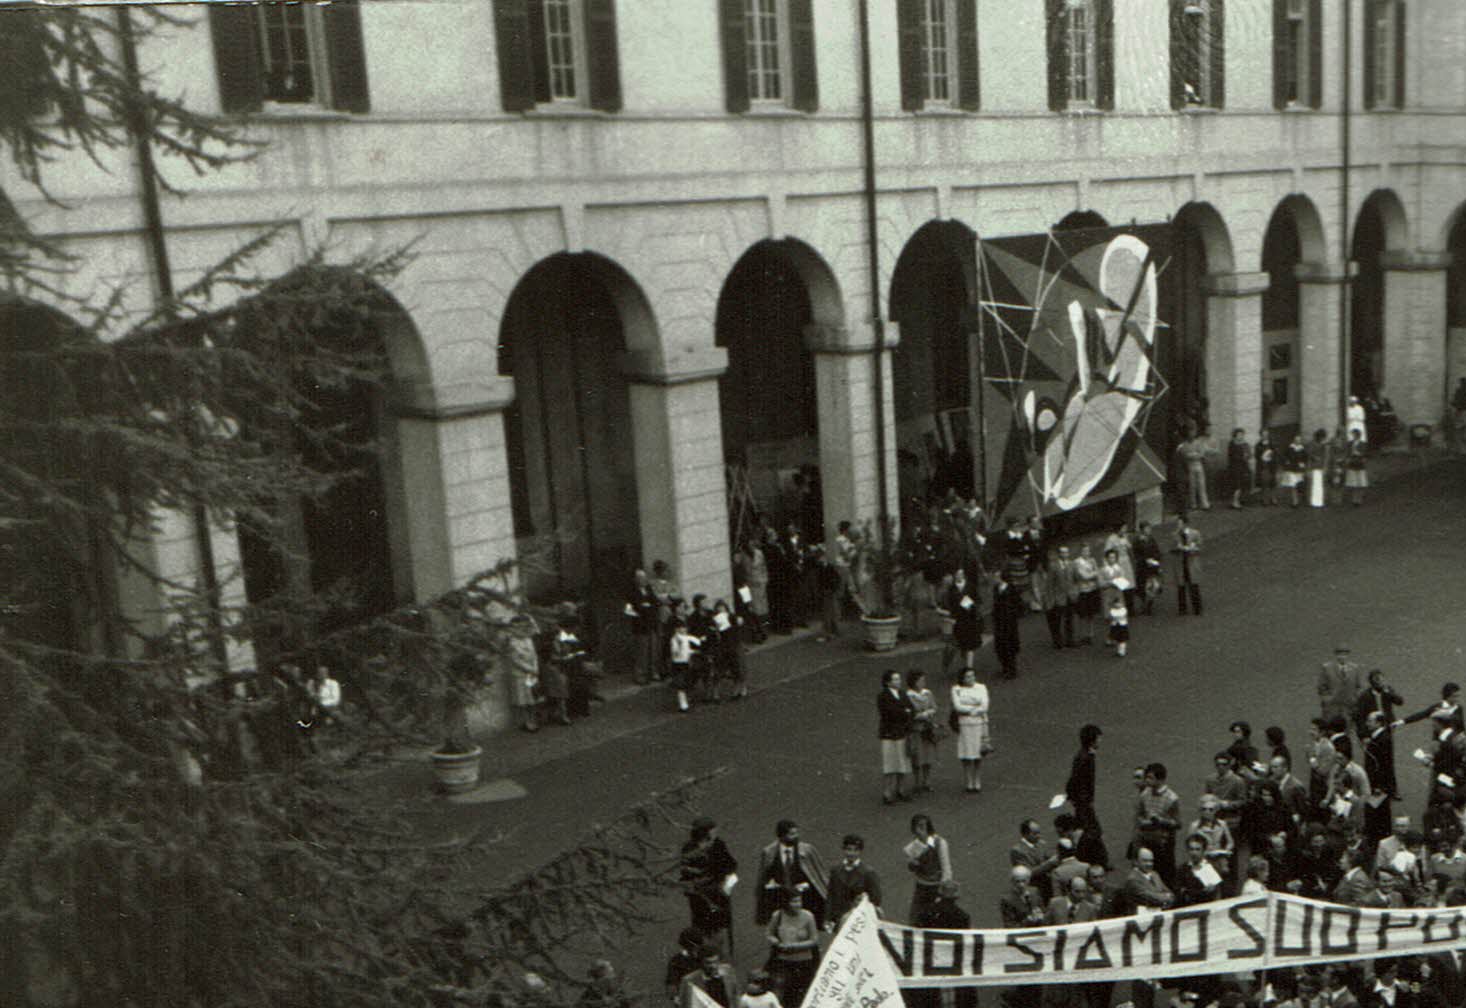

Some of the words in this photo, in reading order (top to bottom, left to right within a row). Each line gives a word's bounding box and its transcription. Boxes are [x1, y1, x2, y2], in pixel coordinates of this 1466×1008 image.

[877, 928, 986, 977] NOI
[1003, 910, 1210, 973] SIAMO
[1227, 896, 1361, 958] SUO
